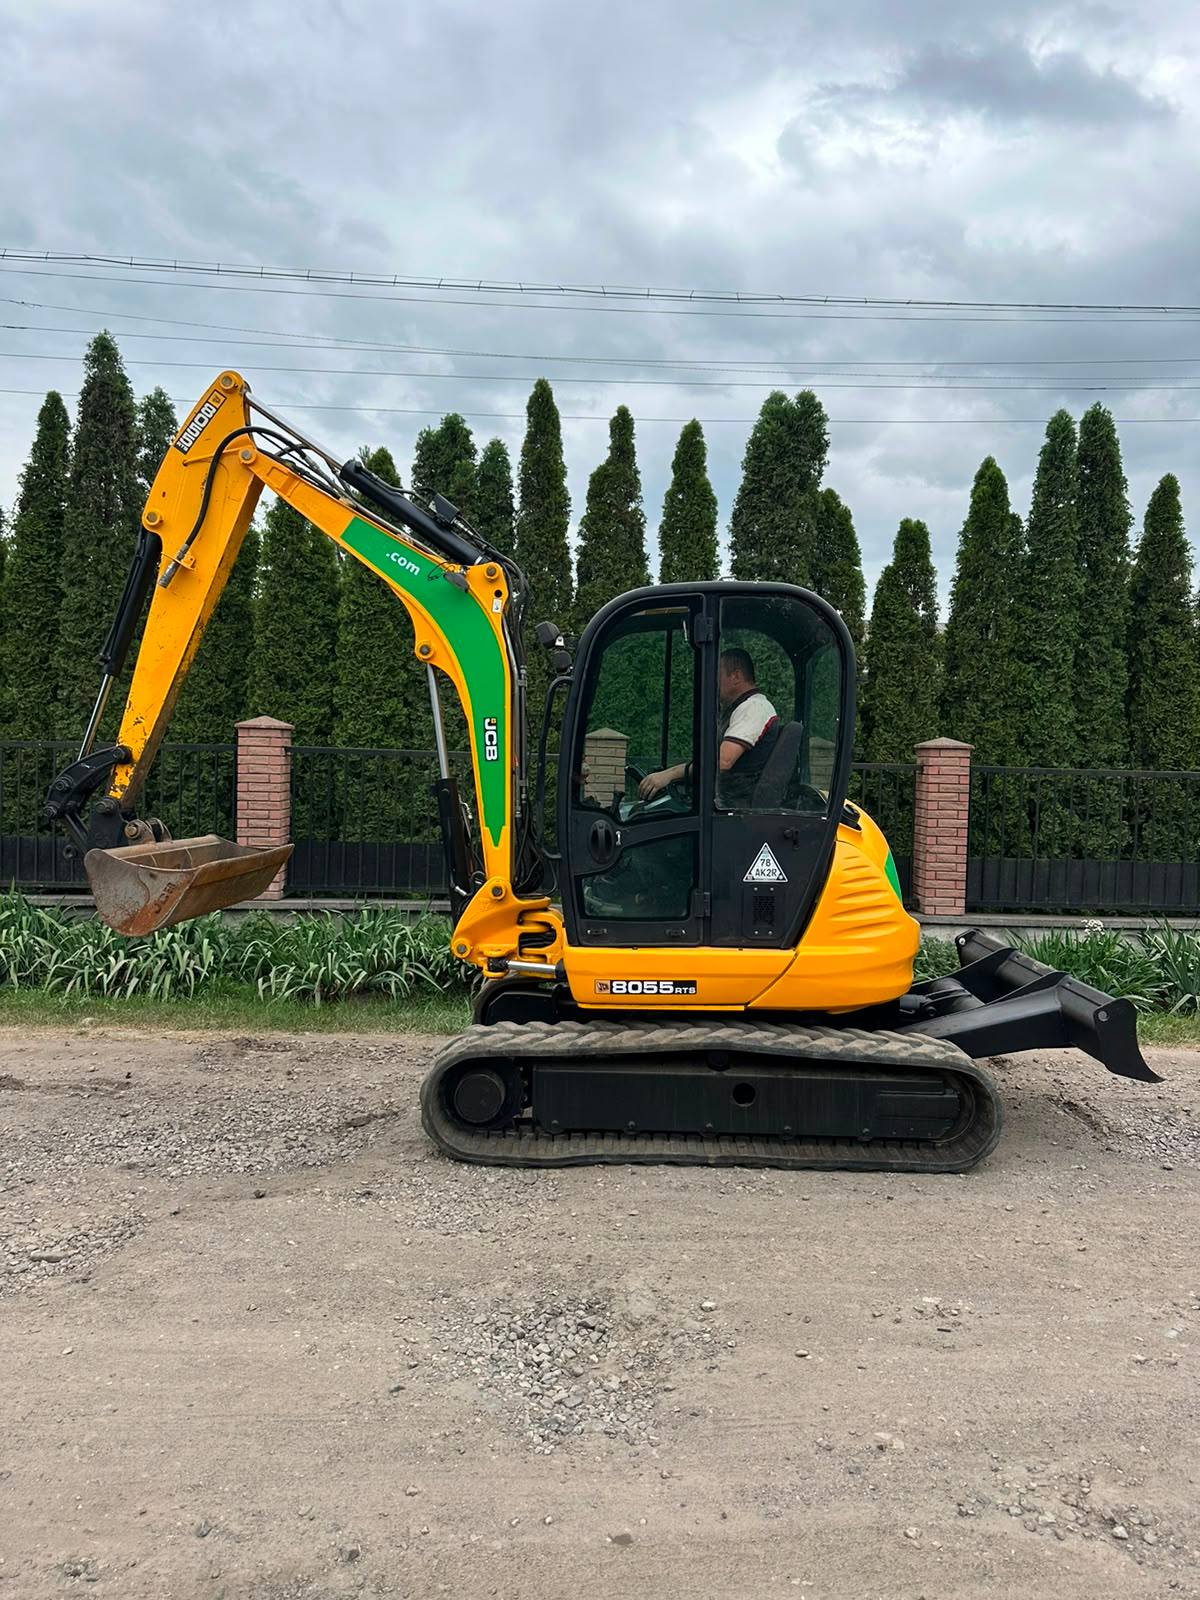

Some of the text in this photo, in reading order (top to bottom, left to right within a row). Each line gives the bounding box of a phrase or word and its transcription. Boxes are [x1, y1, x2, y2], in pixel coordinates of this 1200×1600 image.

[180, 402, 217, 448] 8055
[385, 552, 421, 576] .com
[484, 717, 498, 761] JCB
[755, 868, 778, 877] AK2R
[760, 858, 771, 867] 78
